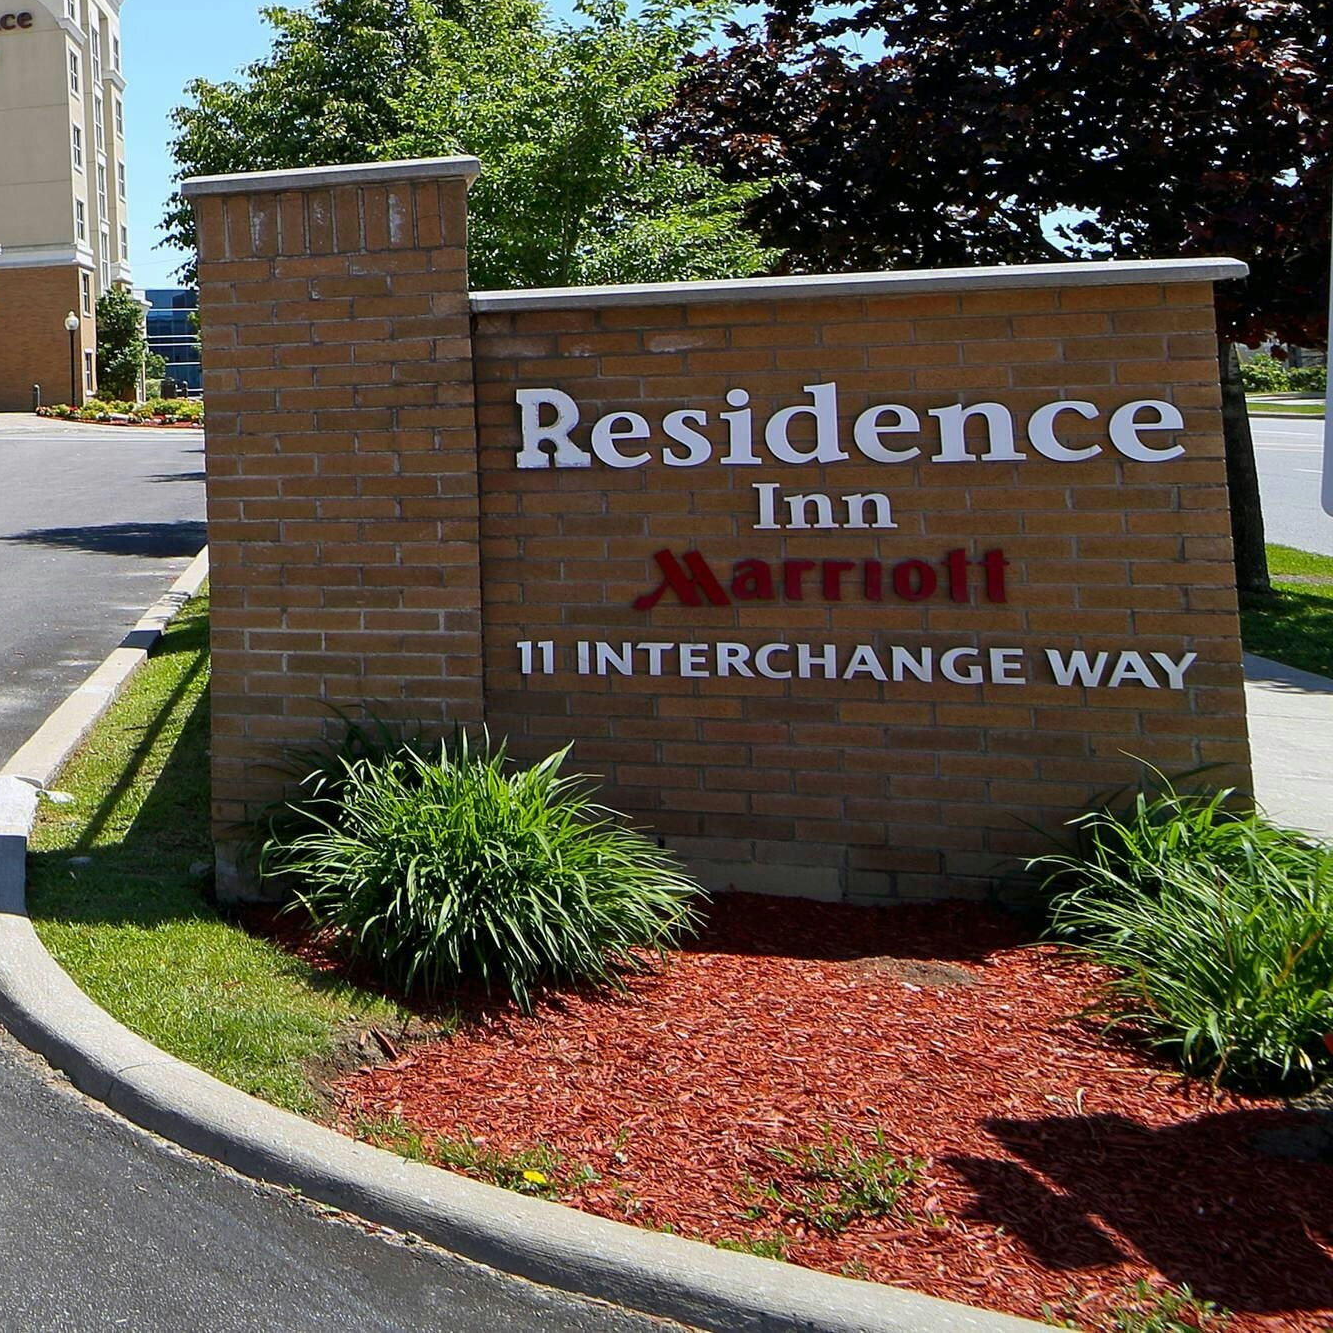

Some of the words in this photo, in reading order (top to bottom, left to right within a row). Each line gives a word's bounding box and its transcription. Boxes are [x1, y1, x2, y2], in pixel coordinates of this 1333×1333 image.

[515, 381, 1187, 469] Residence
[751, 481, 899, 531] Inn
[633, 547, 1012, 612] Marriott
[516, 640, 555, 676] 11
[577, 641, 1028, 687] INTERCHANGE
[1044, 649, 1198, 691] WAY
